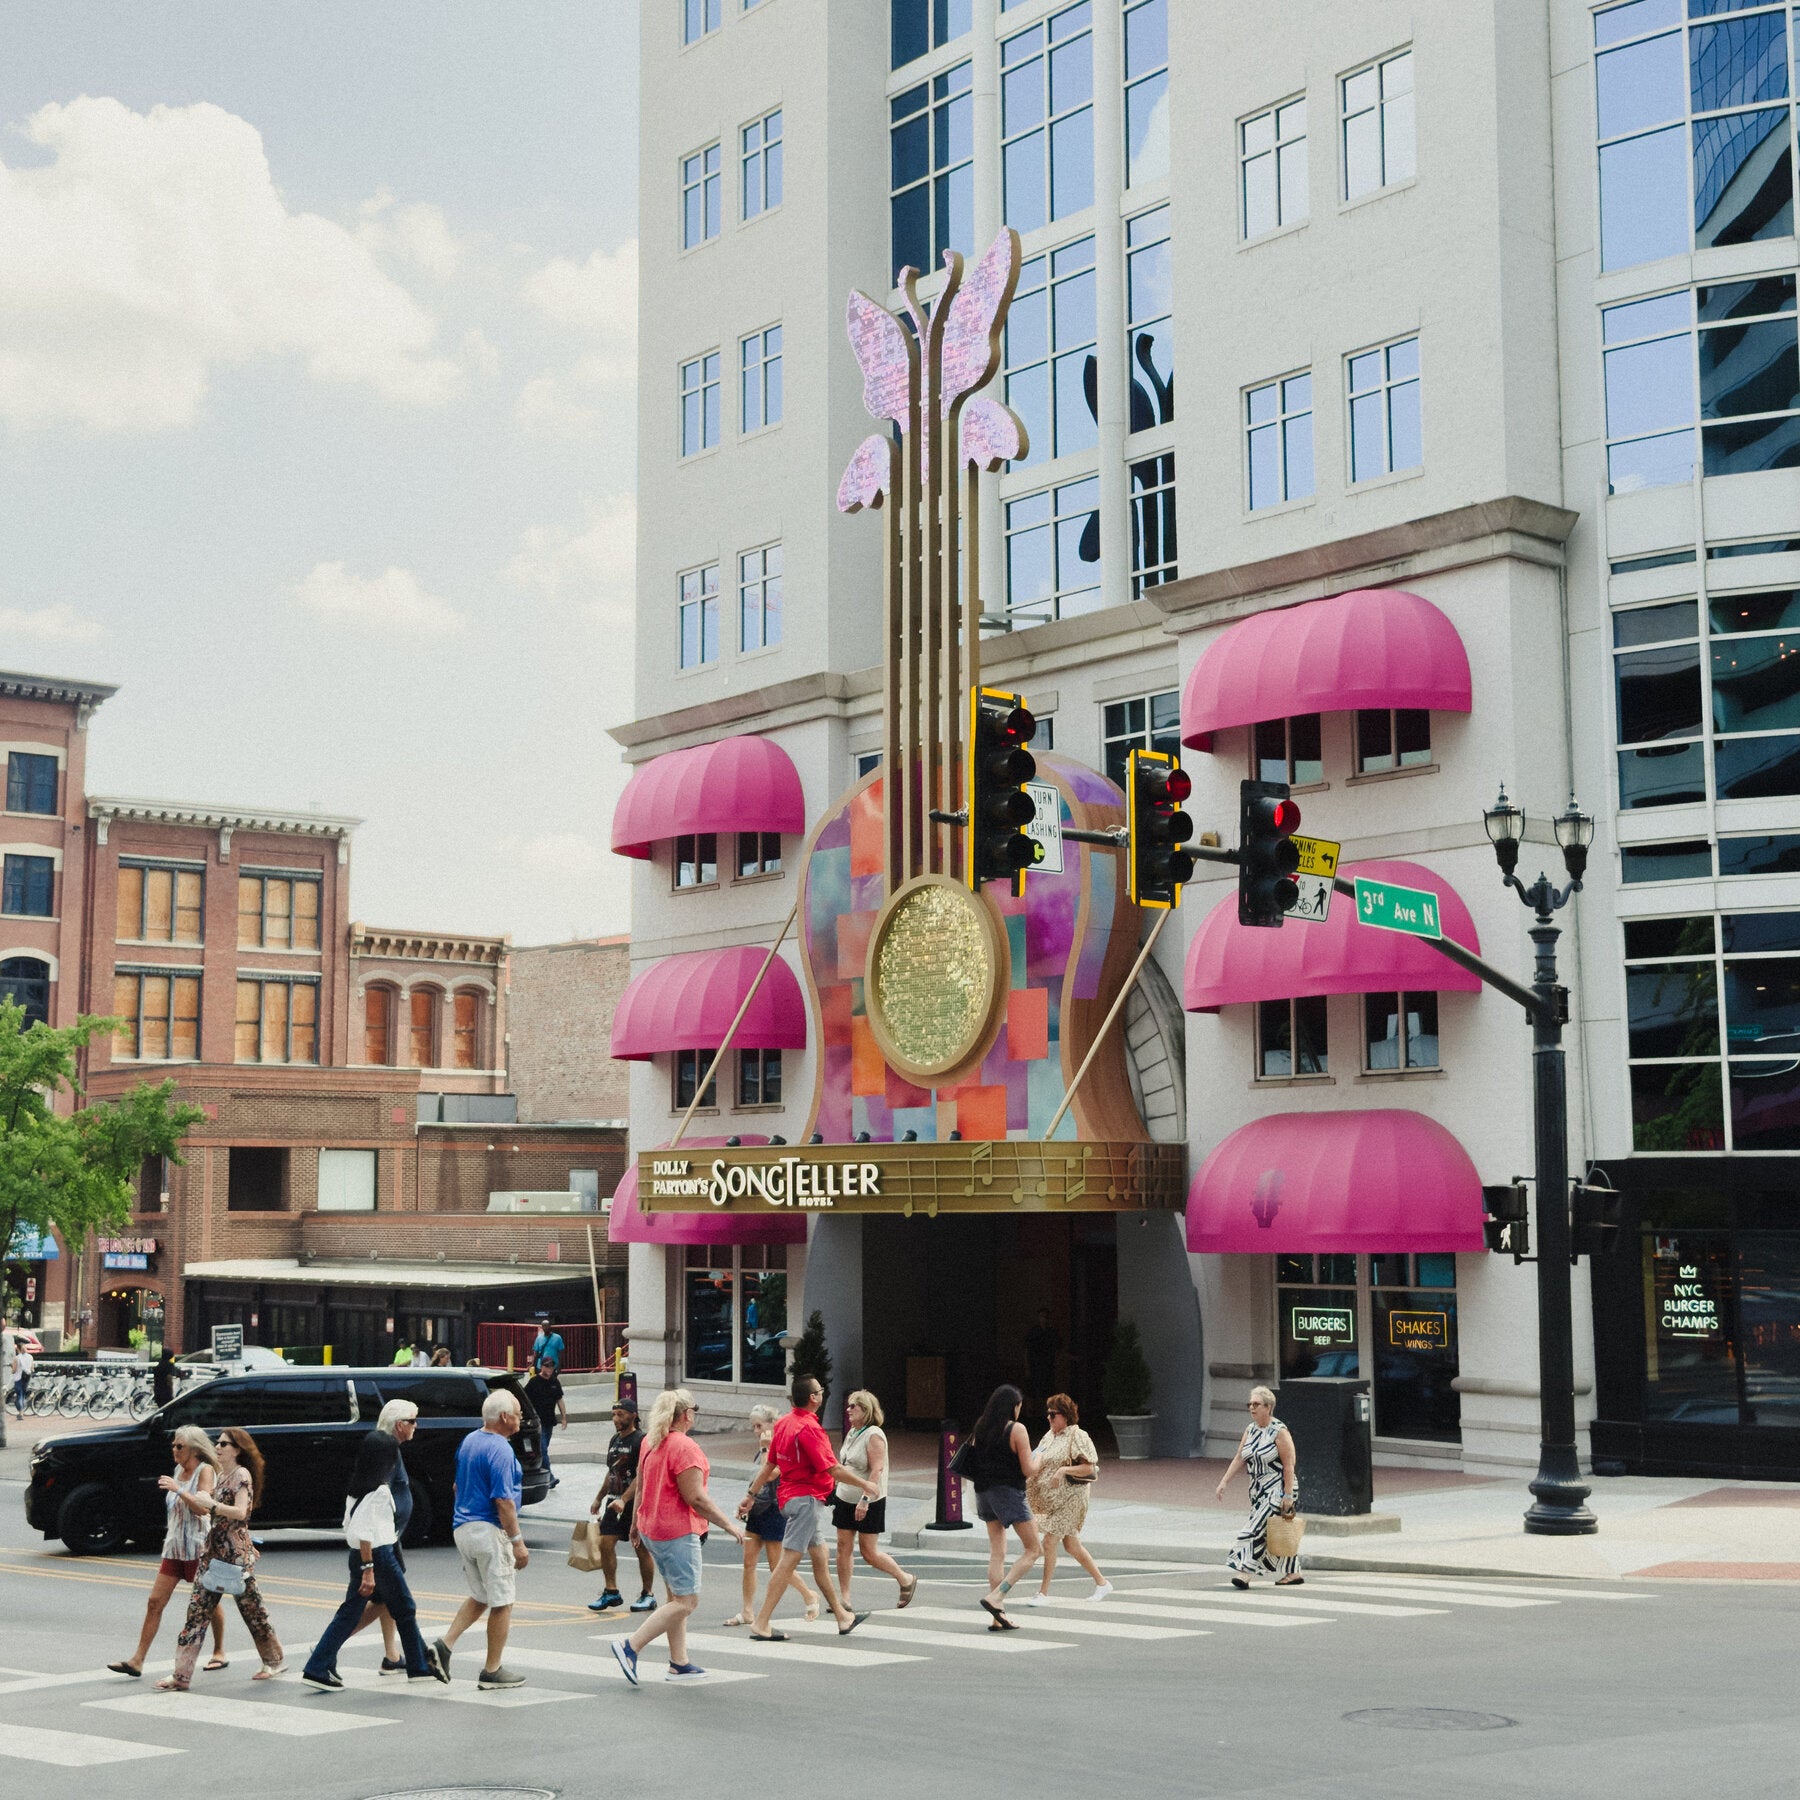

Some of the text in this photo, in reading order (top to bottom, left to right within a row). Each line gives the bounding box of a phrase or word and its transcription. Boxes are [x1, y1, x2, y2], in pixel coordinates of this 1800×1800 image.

[1033, 790, 1053, 805] TURN
[1027, 822, 1058, 838] LASHING
[1362, 890, 1434, 926] 3rd Ave N
[652, 1160, 689, 1175] DOLLY
[652, 1178, 709, 1195] PARTON'S
[709, 1157, 880, 1207] SONGTELLER
[798, 1197, 834, 1207] HOTEL
[1673, 1284, 1704, 1297] NYC
[1663, 1299, 1715, 1313] BURGER
[1298, 1316, 1347, 1332] BURGERS
[1396, 1320, 1441, 1336] SHAKES
[1661, 1315, 1719, 1329] CHAMPS
[1313, 1335, 1332, 1345] BEER
[1404, 1339, 1433, 1350] WINGS
[949, 1450, 958, 1512] VLET
